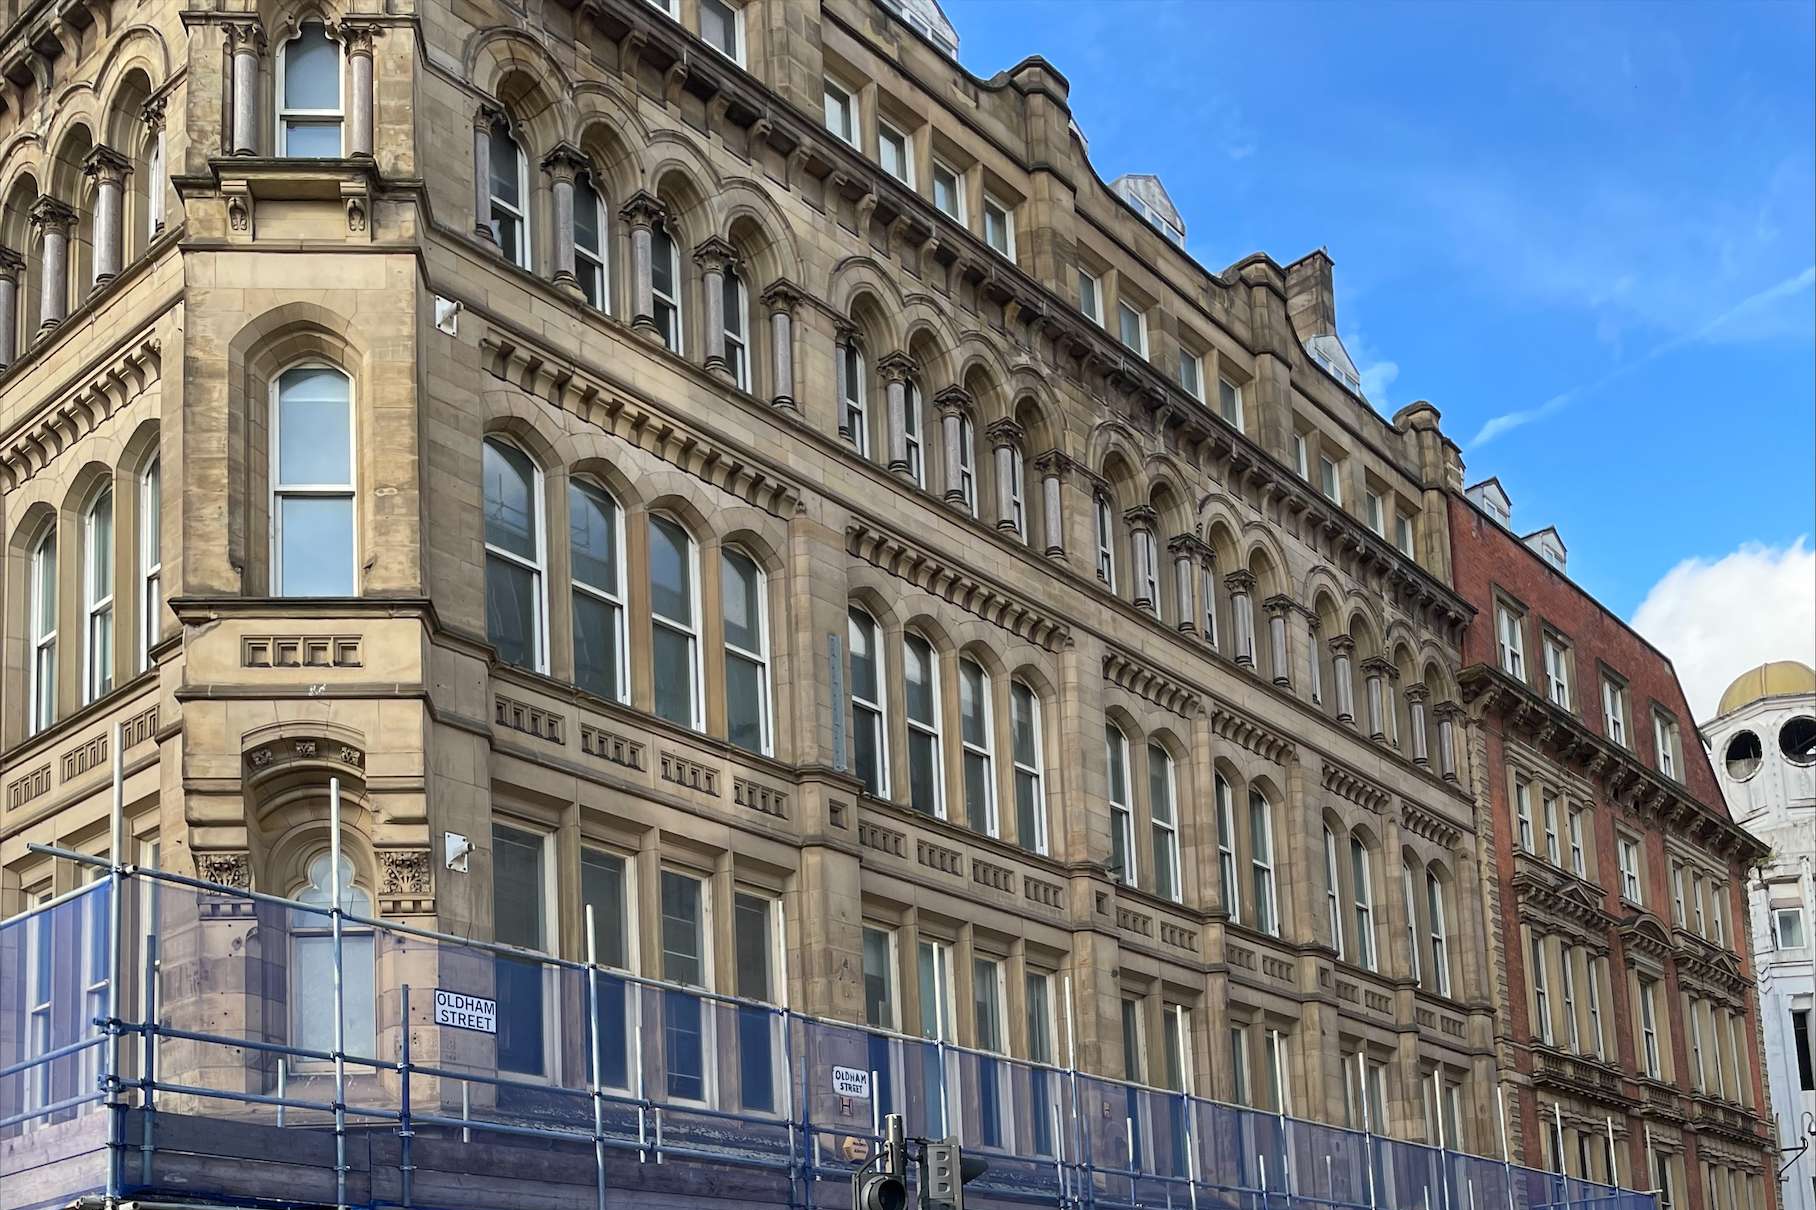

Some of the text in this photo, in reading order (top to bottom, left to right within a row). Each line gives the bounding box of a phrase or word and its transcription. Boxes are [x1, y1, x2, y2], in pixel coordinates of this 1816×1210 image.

[437, 993, 495, 1016] OLDHAM
[441, 1009, 492, 1030] STREET
[835, 1070, 867, 1084] OLDHAM
[840, 1082, 862, 1094] STREET
